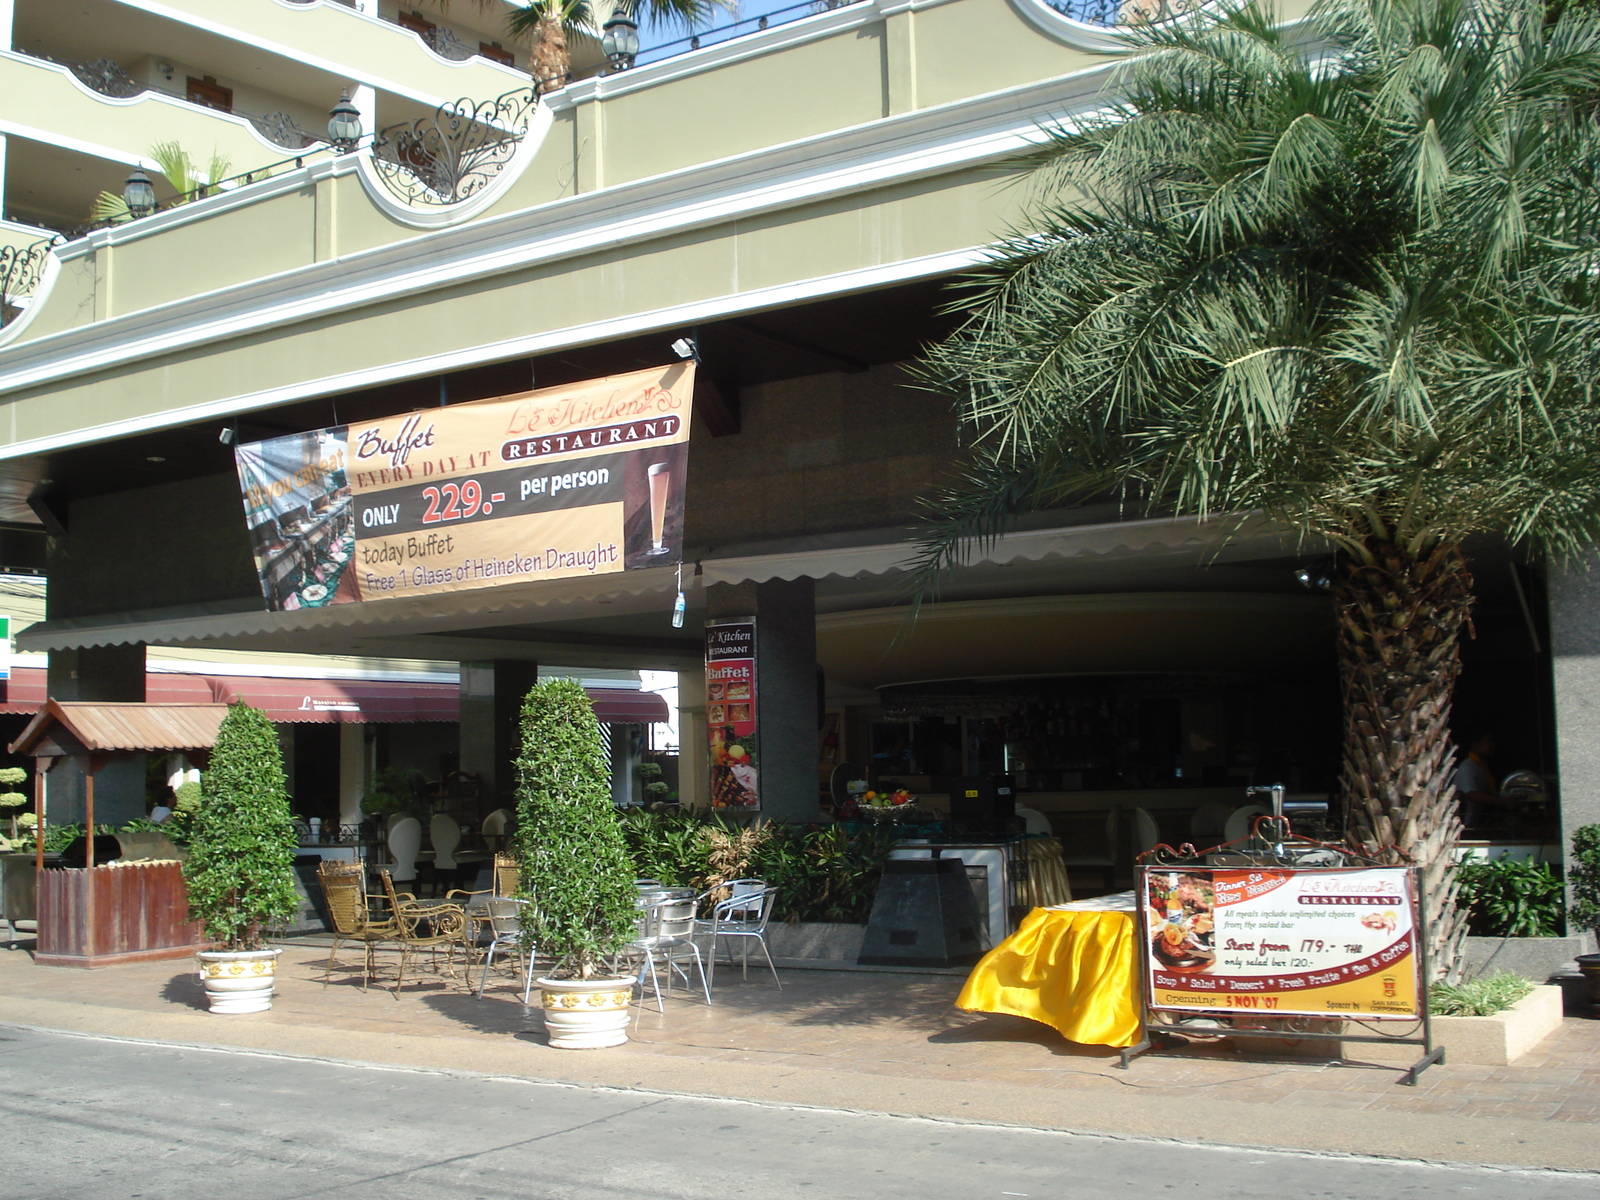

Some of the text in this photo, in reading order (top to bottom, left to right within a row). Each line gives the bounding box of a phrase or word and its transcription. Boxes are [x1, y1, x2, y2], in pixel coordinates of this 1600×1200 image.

[355, 413, 435, 468] Buffet
[508, 419, 675, 459] RESTAURANT
[263, 475, 293, 506] you
[294, 463, 320, 489] can
[318, 447, 344, 475] eat
[356, 450, 491, 488] EVERY DAY AT
[362, 467, 610, 528] ONLY 229.- per person
[363, 533, 455, 566] today Buffet
[366, 542, 619, 592] Free 1 Glass of Heineken Draught
[717, 629, 751, 644] Kitchen
[707, 666, 750, 680] Buffet
[1215, 873, 1264, 893] Dinner Set
[1215, 892, 1242, 905] New
[1301, 896, 1401, 904] RESTAURANT
[1223, 909, 1356, 919] All meals include unlimited choices
[1223, 920, 1294, 929] from the salad bar
[1223, 938, 1255, 950] Start
[1259, 938, 1290, 956] from
[1156, 975, 1178, 986] Soup
[1190, 978, 1216, 989] Salad
[1229, 979, 1265, 990] Dessert
[1278, 977, 1306, 989] Fresh
[1351, 963, 1371, 976] Tea
[1380, 941, 1410, 963] Coffee
[1224, 957, 1242, 969] only
[1245, 957, 1269, 967] salad
[1271, 957, 1287, 967] bar
[1166, 993, 1216, 1007] Openning
[1226, 995, 1233, 1007] 5
[1235, 995, 1259, 1008] NOV
[1352, 1001, 1361, 1010] by
